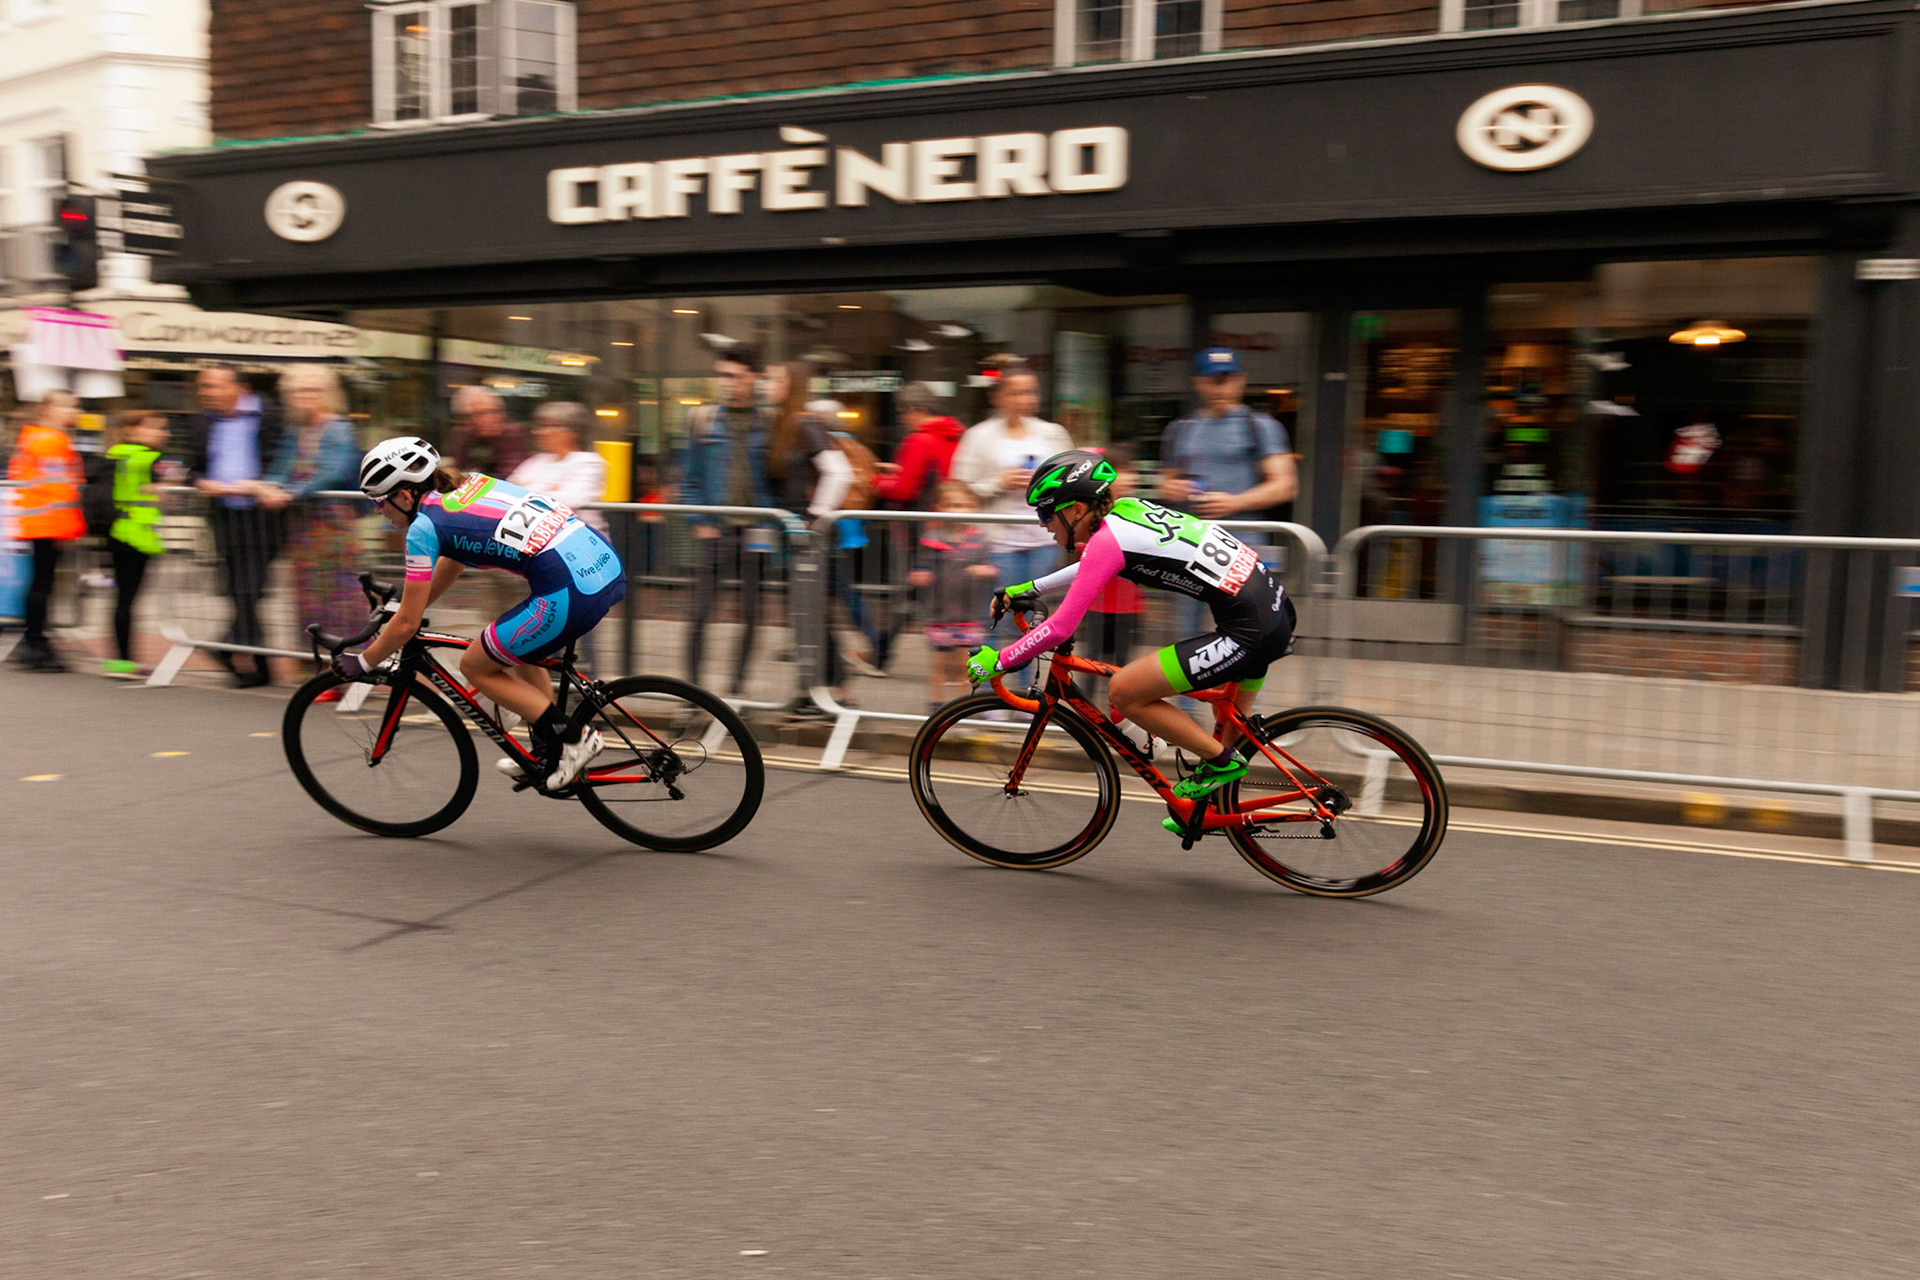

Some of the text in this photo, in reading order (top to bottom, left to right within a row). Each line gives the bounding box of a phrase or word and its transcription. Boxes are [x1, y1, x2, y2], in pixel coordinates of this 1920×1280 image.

[546, 125, 1129, 225] CAFFÈ NERO
[509, 601, 557, 650] CARBON
[1008, 625, 1052, 662] JAKROO
[1188, 636, 1240, 675] KTM
[429, 671, 507, 744] SPECIALIZED
